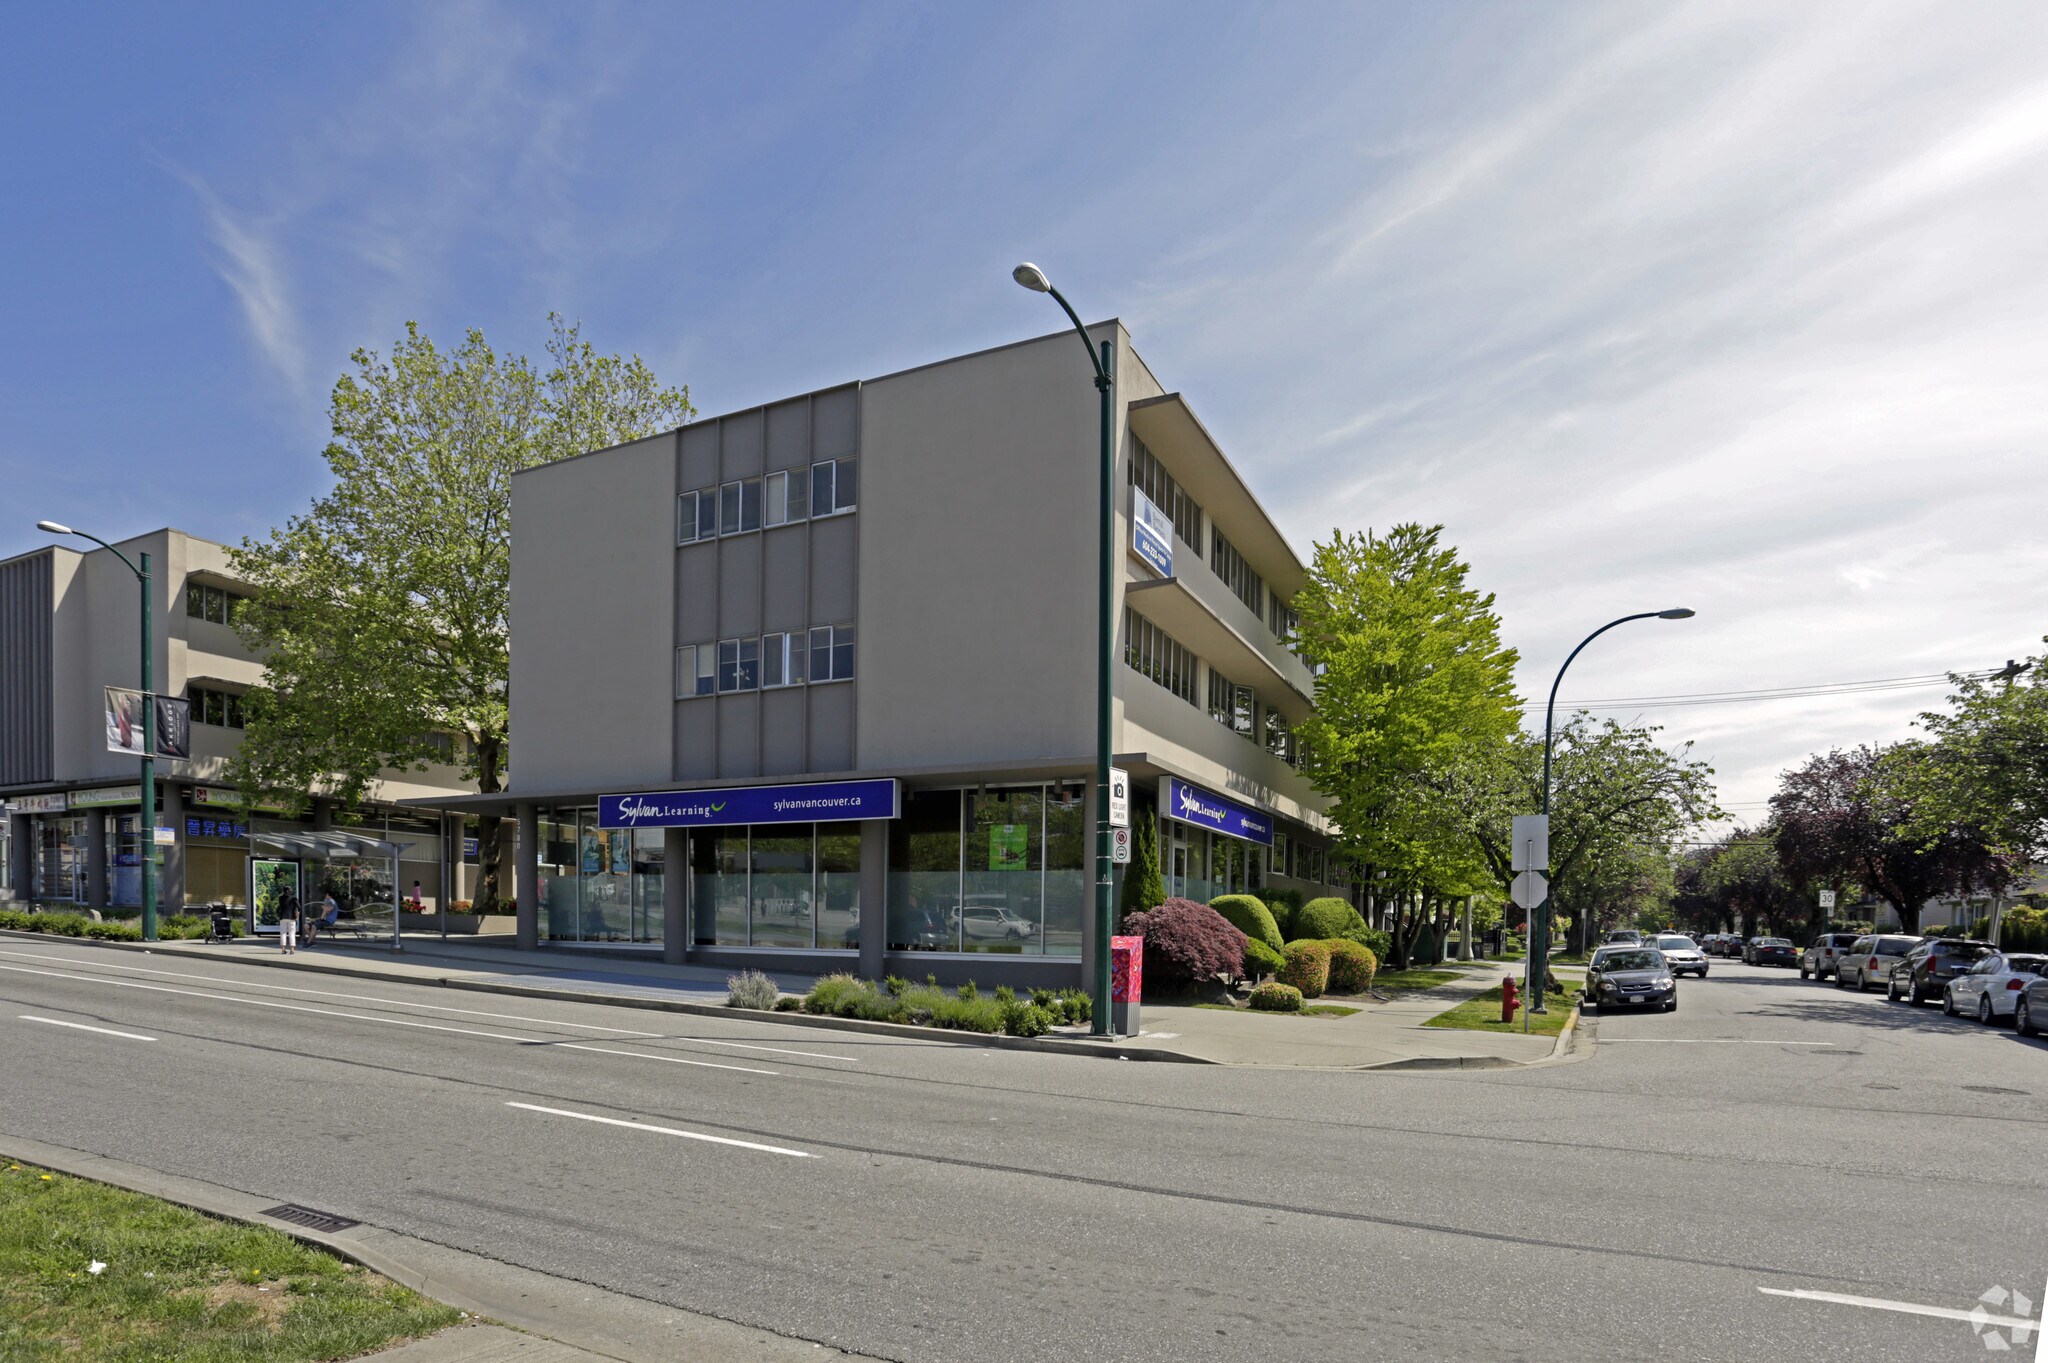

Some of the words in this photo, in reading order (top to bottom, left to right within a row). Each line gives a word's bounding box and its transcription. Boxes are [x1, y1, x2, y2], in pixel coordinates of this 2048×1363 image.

[210, 790, 243, 802] YOUN
[1118, 803, 1127, 811] LIGHT
[1180, 785, 1202, 818] Sylvan
[1201, 803, 1221, 823] Learning
[618, 796, 664, 825] Sylvan
[664, 804, 711, 818] Learning
[773, 795, 862, 811] sylvanvancouver.ca
[1113, 811, 1125, 820] CAMERA
[1821, 894, 1833, 903] 30
